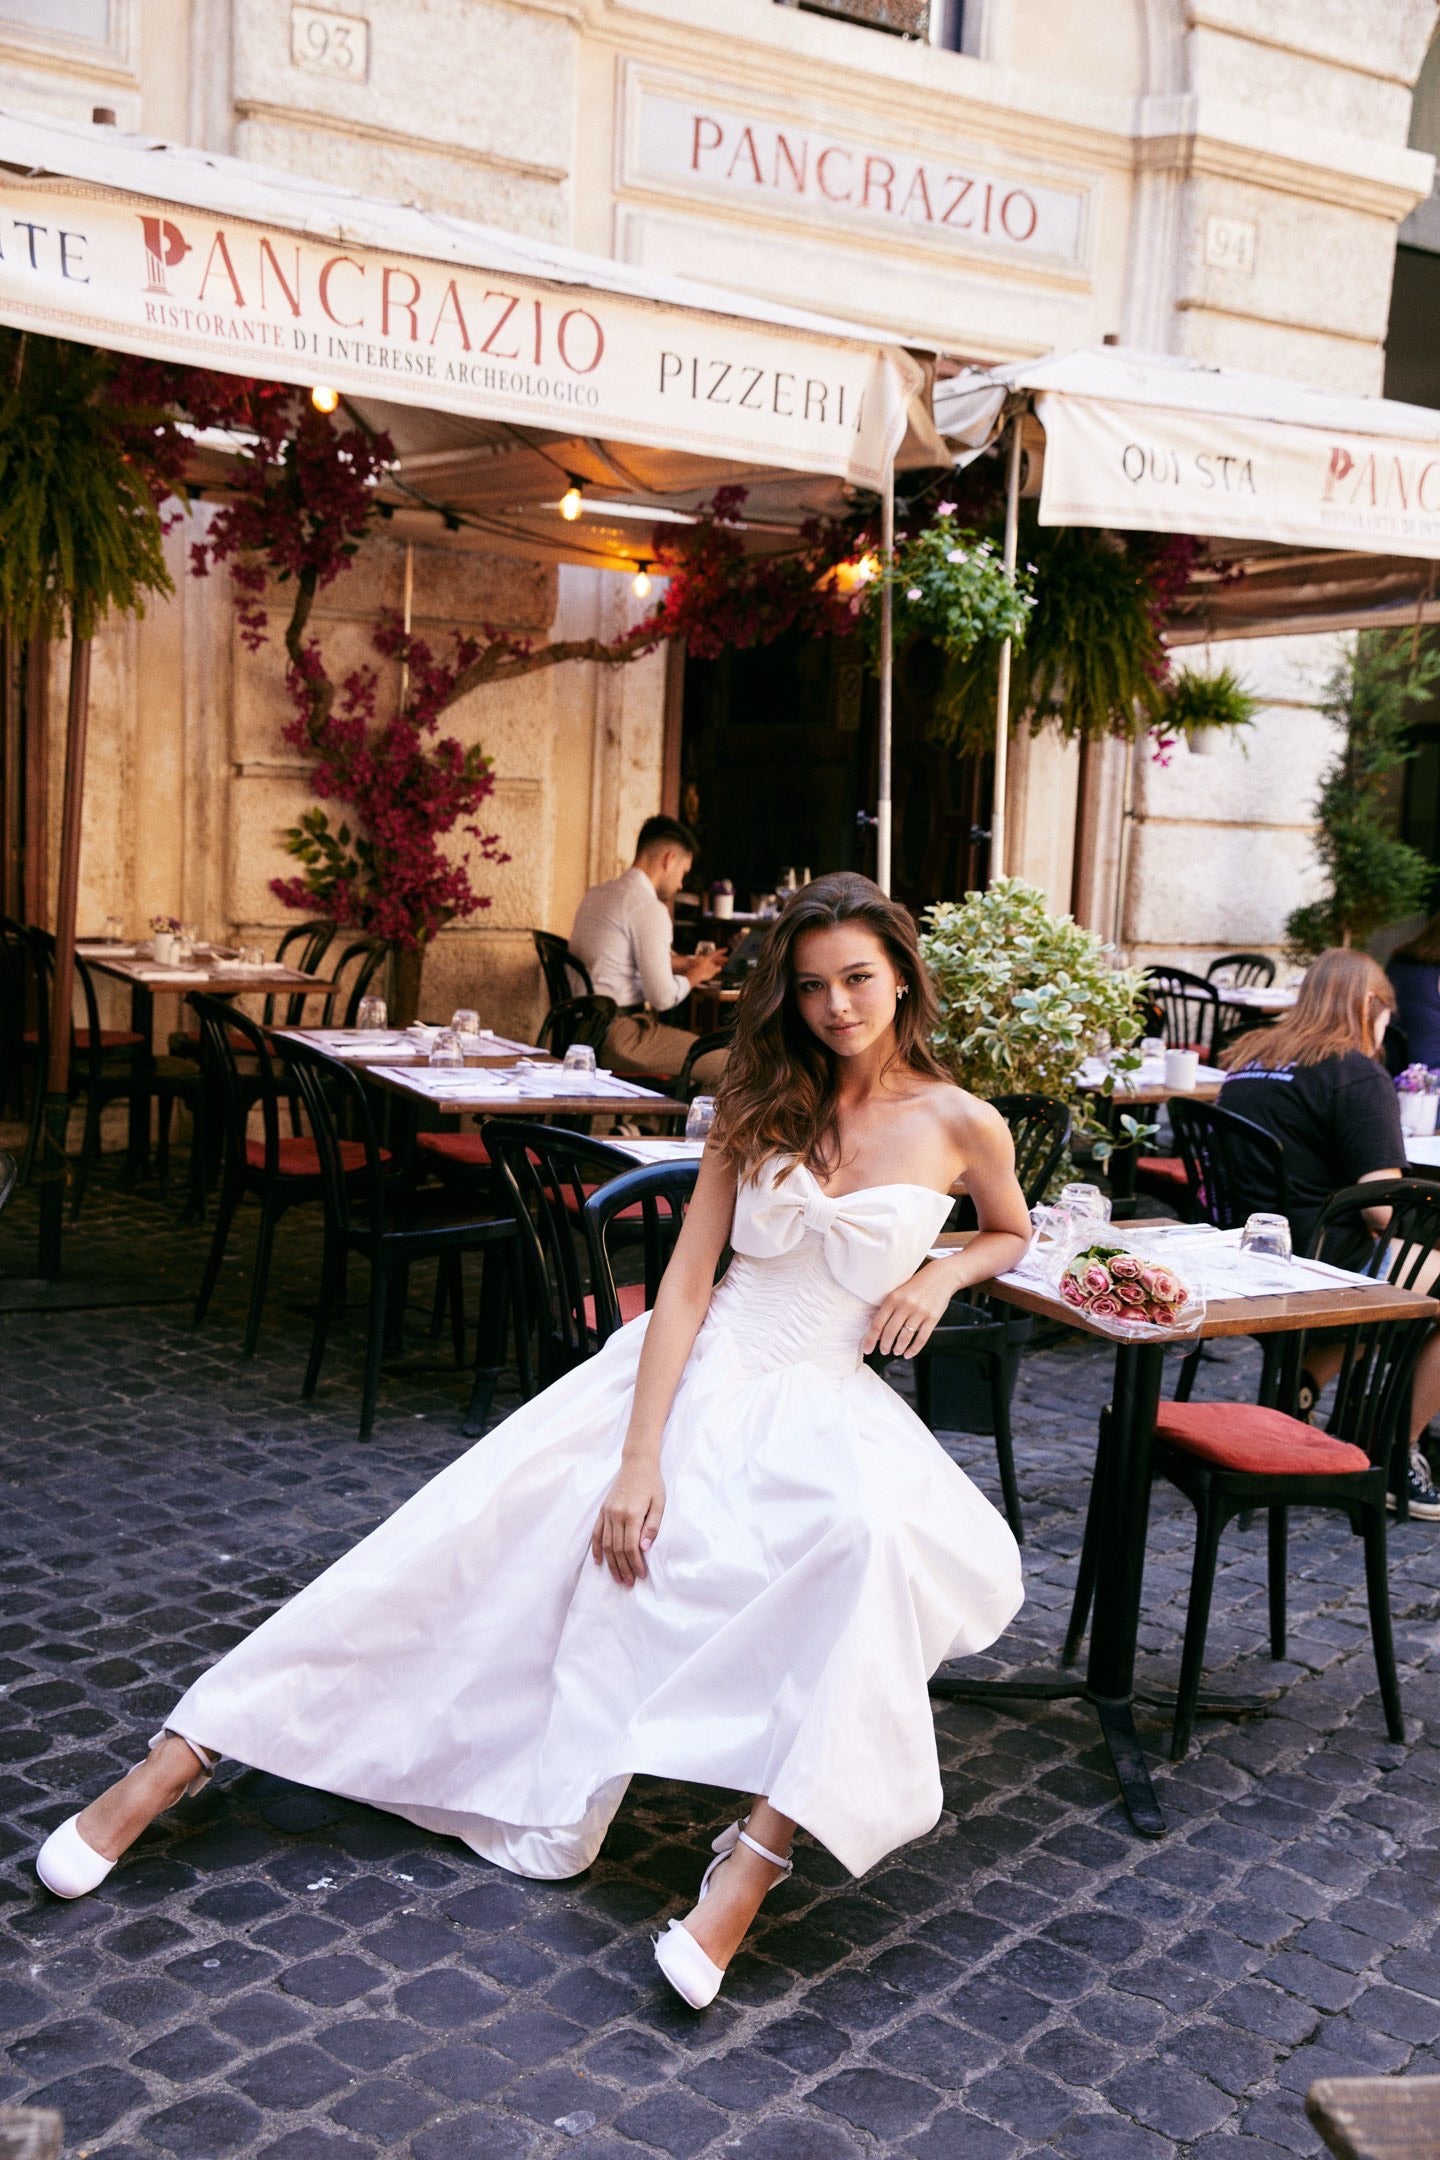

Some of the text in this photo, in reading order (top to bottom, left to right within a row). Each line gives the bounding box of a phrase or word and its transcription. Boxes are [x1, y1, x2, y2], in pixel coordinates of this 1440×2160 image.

[301, 19, 353, 70] 93
[690, 114, 1038, 242] PANCRAZIO
[0, 220, 90, 284] TE
[137, 214, 605, 374] PANCRAZIO
[143, 301, 600, 408] RISTORANTE DI INTERESSE ARCHEOLOGICO
[1195, 452, 1257, 495] STA
